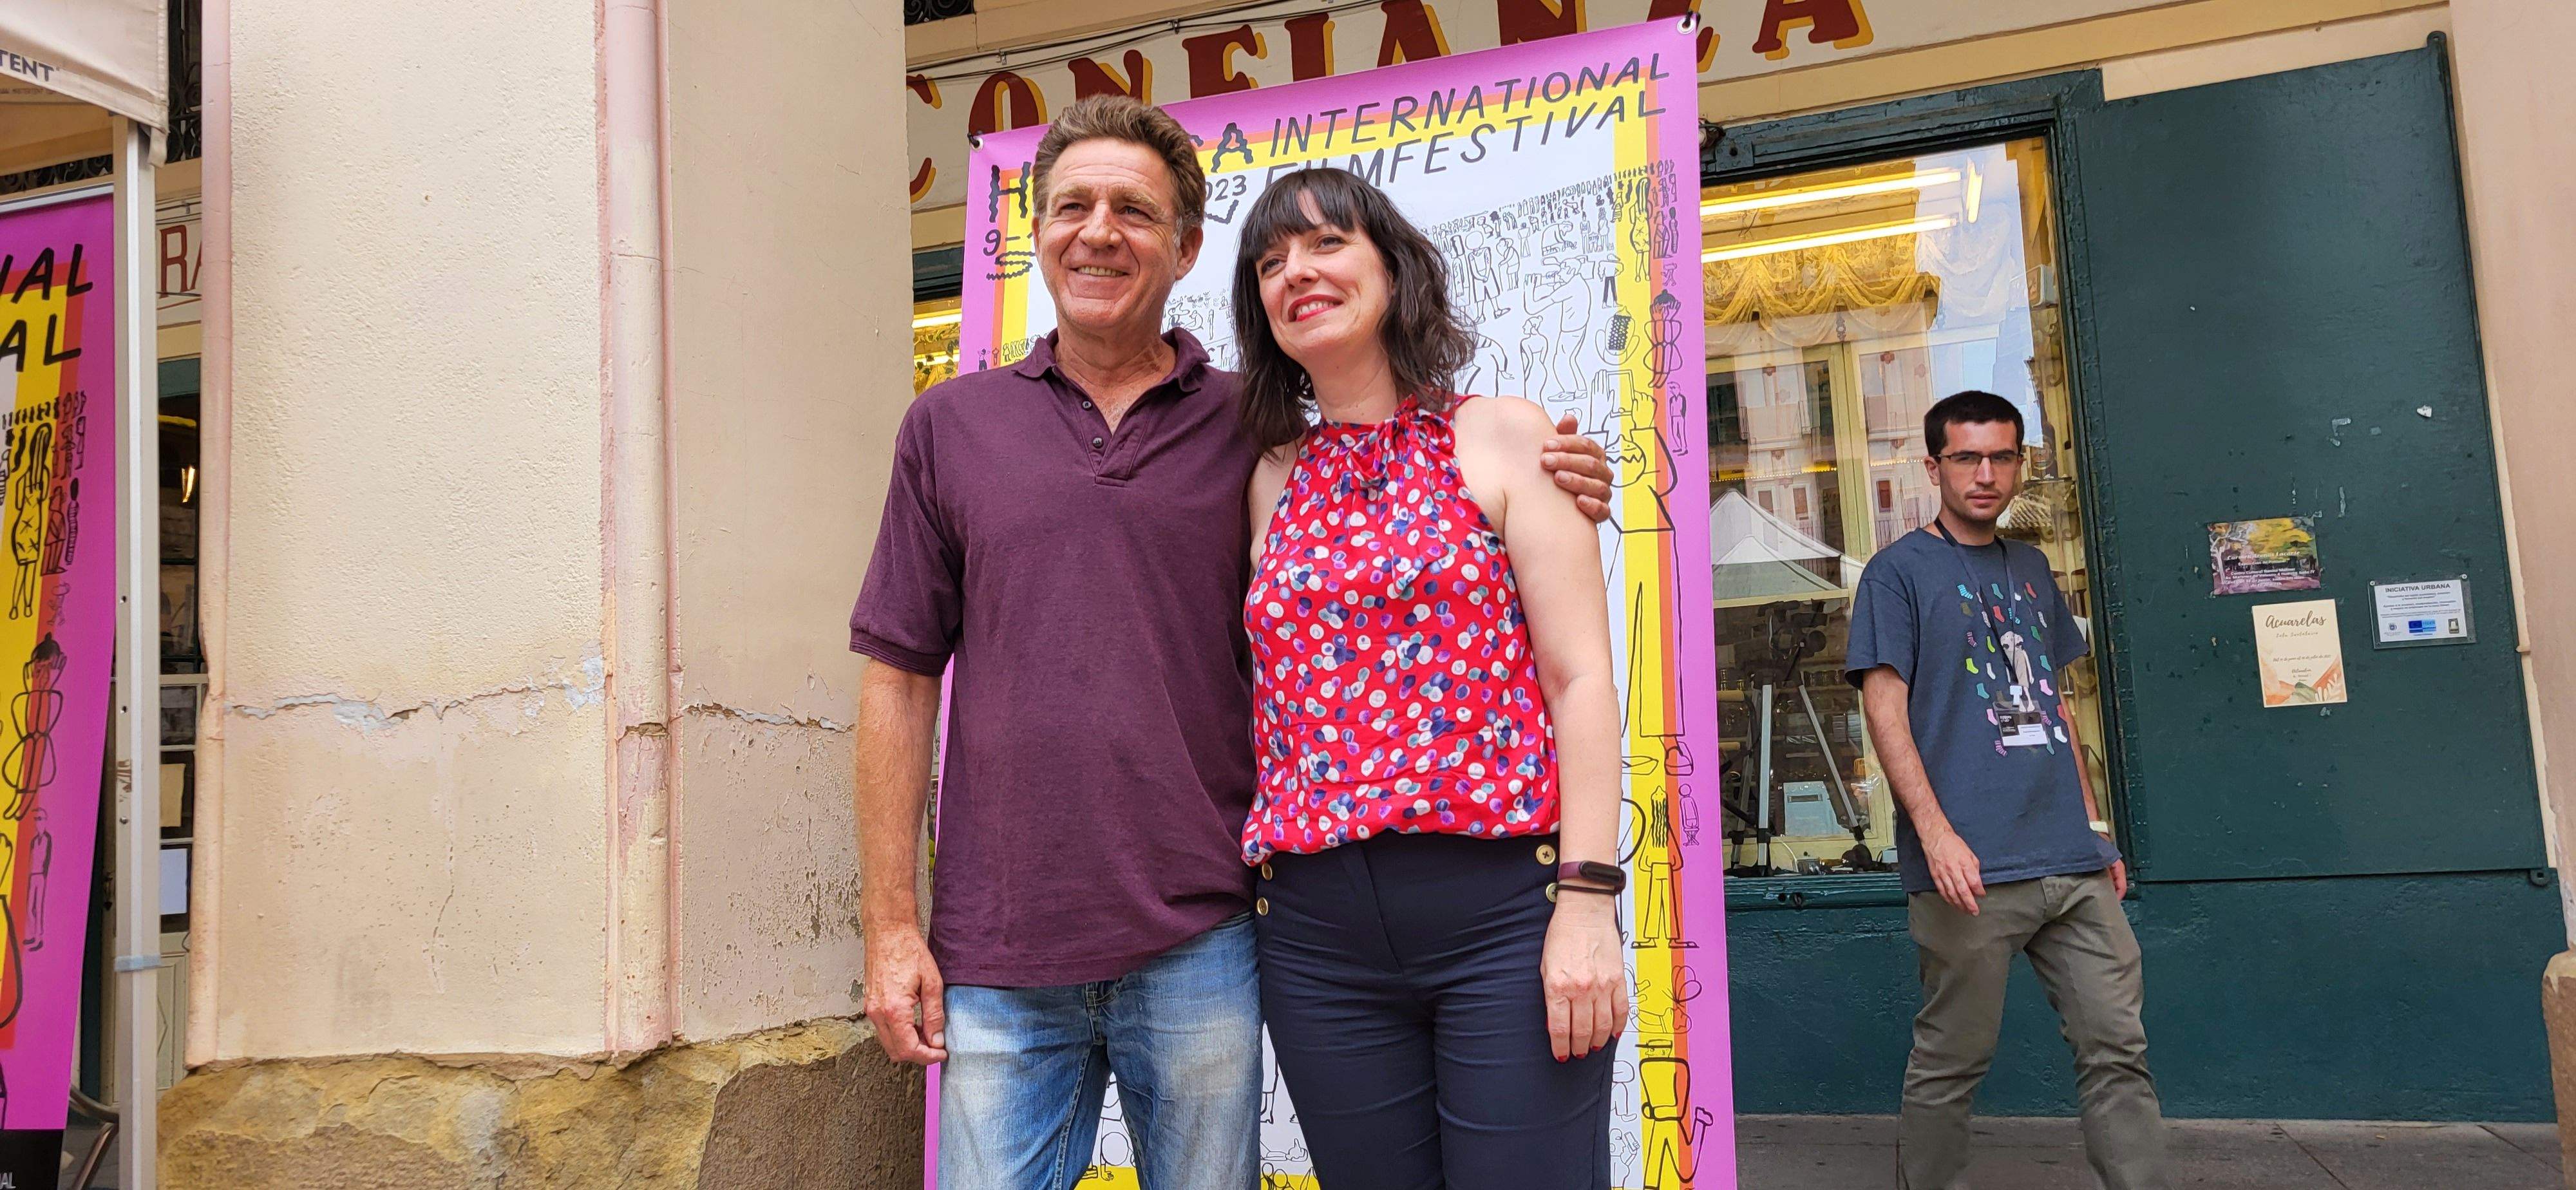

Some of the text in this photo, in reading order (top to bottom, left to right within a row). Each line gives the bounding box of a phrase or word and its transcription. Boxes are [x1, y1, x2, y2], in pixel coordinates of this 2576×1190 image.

[1270, 53, 1669, 158] INTERNATIONAL
[1265, 90, 1665, 193] MFESTIVAL
[1206, 175, 1247, 202] 23
[2265, 610, 2326, 629] Acuarelas
